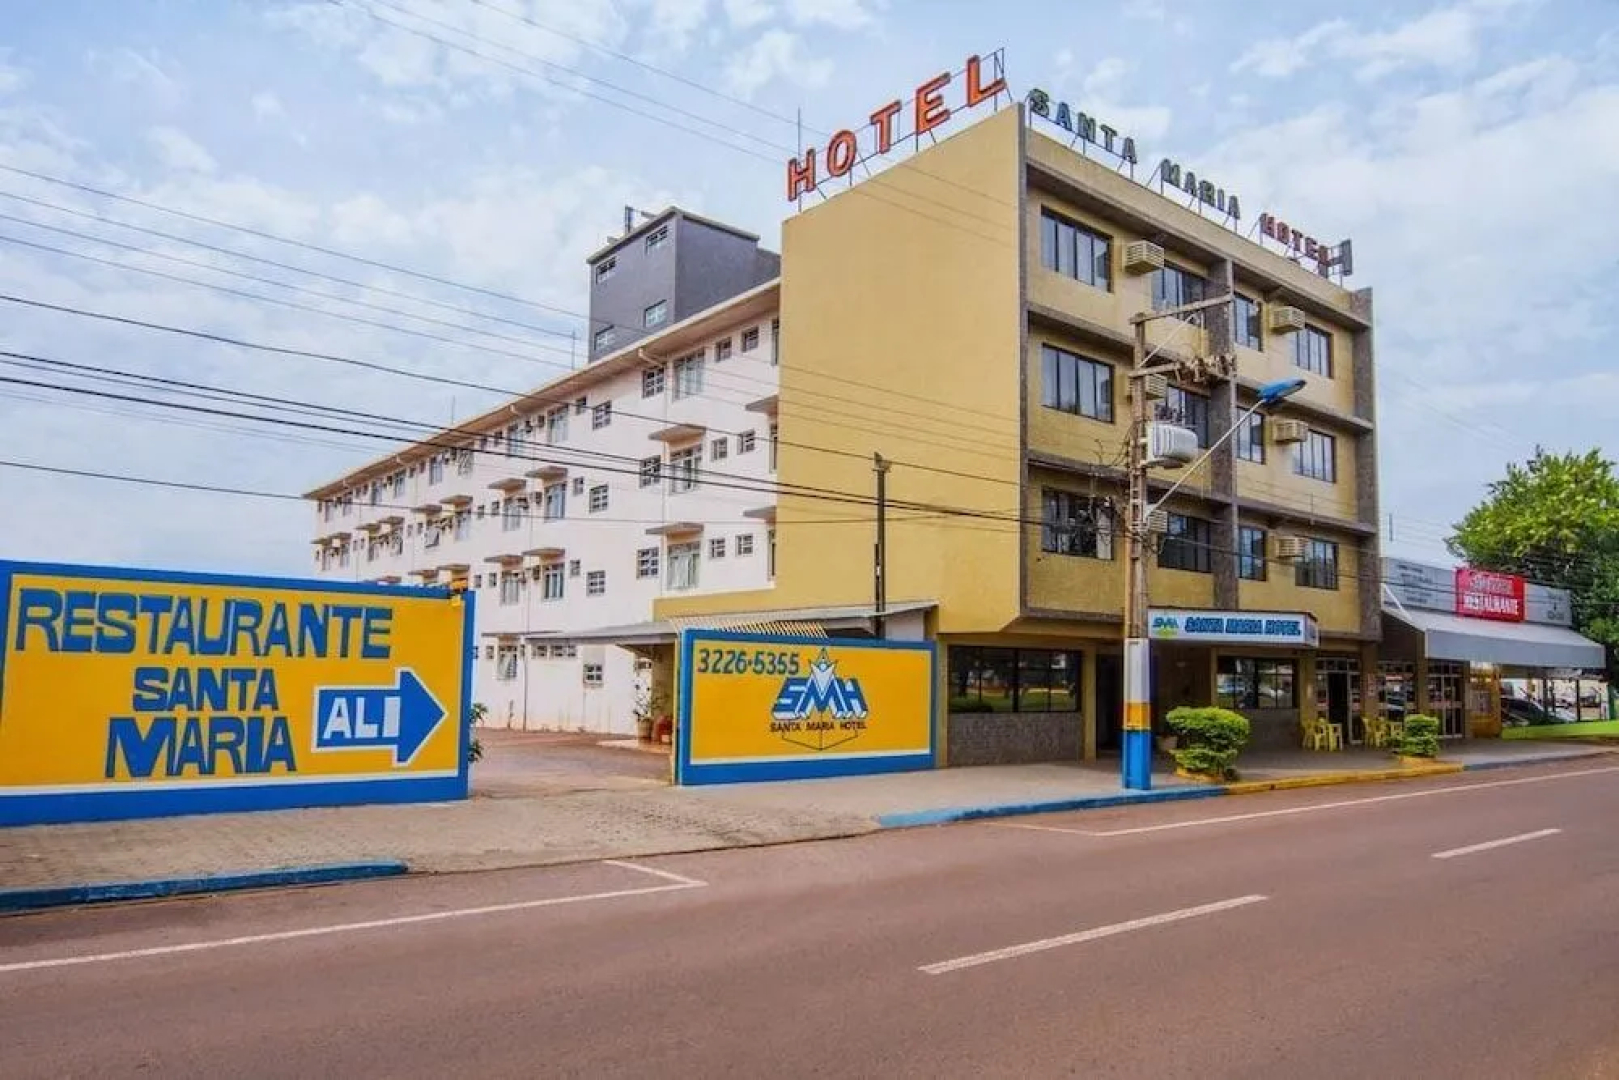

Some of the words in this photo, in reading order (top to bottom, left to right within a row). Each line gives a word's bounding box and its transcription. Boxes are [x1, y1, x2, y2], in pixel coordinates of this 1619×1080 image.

[787, 54, 1007, 202] HOTEL
[1028, 88, 1137, 164] SANTA
[1160, 158, 1241, 220] MARIA
[14, 587, 394, 660] RESTAURANTE
[1184, 617, 1224, 633] SANTA
[1225, 618, 1263, 634] MARIA
[1264, 619, 1302, 636] HOTEL
[131, 666, 279, 713] SANTA
[771, 676, 869, 720] SMH
[322, 696, 400, 741] ALI
[769, 721, 801, 733] SANTA
[806, 721, 835, 731] MARIA
[840, 720, 867, 730] HOTEL
[105, 716, 298, 779] MARIA
